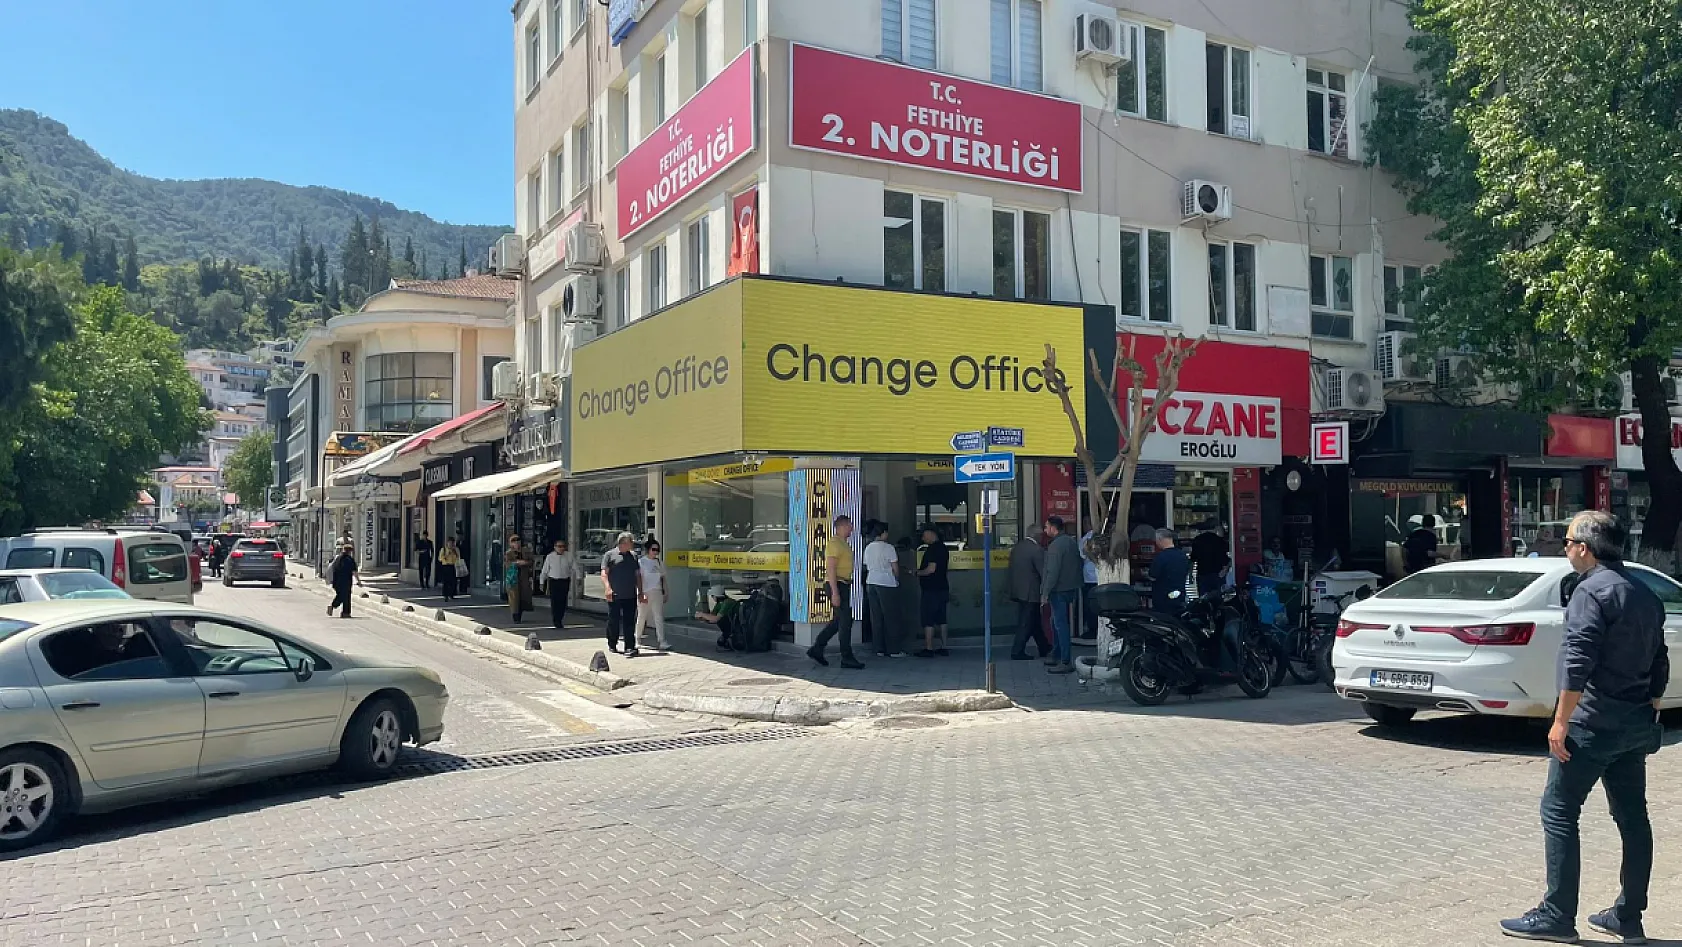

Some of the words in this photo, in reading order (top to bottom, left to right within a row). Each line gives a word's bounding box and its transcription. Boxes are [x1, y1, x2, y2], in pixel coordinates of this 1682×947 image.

[930, 81, 962, 105] T.C.
[668, 119, 683, 141] T.C.
[907, 104, 983, 136] FETHİYE
[659, 133, 693, 174] FETHİYE
[821, 113, 856, 146] 2.
[871, 121, 1060, 181] NOTERLİĞİ
[629, 200, 642, 225] 2.
[646, 117, 734, 213] NOTERLİĞİ
[578, 379, 649, 419] Change
[655, 355, 729, 399] Office
[767, 343, 938, 395] Change
[950, 354, 1066, 394] Office
[1180, 440, 1237, 458] EROĞLU
[1319, 431, 1336, 455] E
[974, 463, 987, 471] TEK
[990, 461, 1005, 470] YÖN
[814, 481, 827, 604] CHANGE
